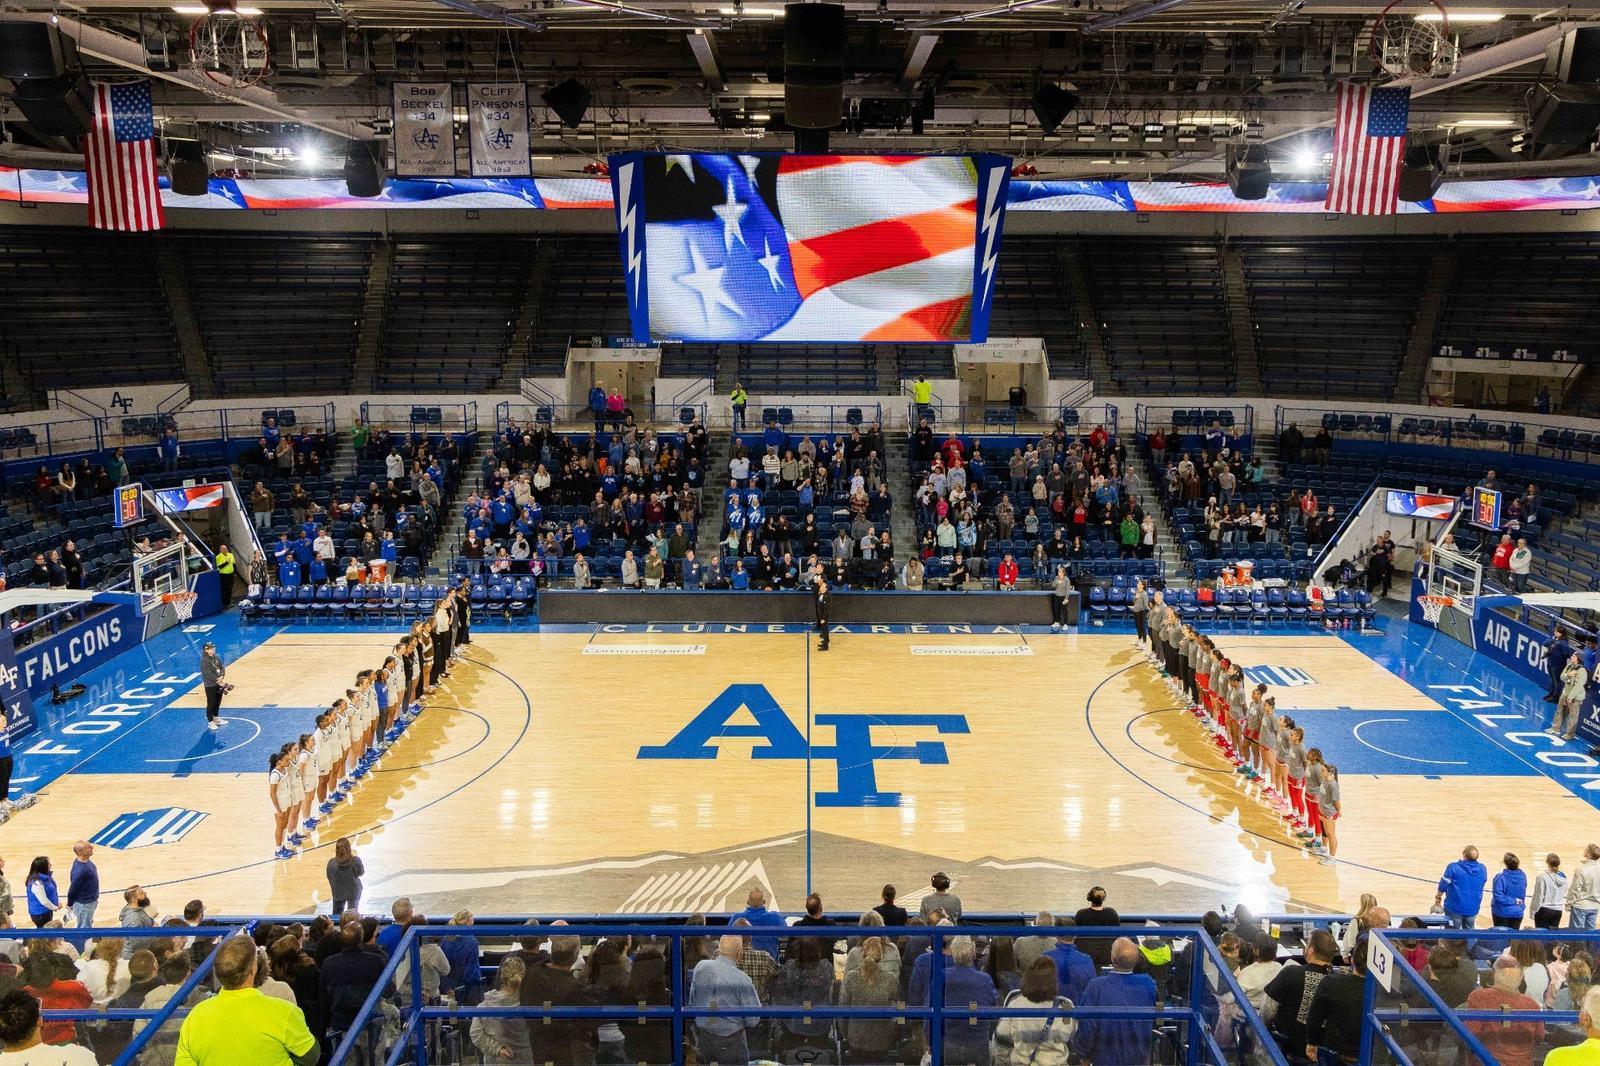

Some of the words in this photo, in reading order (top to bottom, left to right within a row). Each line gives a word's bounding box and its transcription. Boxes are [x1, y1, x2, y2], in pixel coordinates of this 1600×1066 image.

[401, 99, 447, 109] BECKEL
[472, 100, 525, 109] PARSONS
[487, 112, 510, 121] #34
[110, 391, 134, 414] AF
[123, 499, 136, 520] 30
[1479, 503, 1493, 524] 30
[602, 624, 786, 633] CLUNE
[829, 624, 1015, 633] ARENA
[24, 617, 122, 688] FALCONS
[1484, 619, 1511, 653] AIR
[1515, 633, 1549, 675] FOR
[0, 663, 18, 690] AF
[23, 672, 202, 755] FORCE
[636, 683, 971, 807] AF
[1373, 945, 1386, 975] L3
